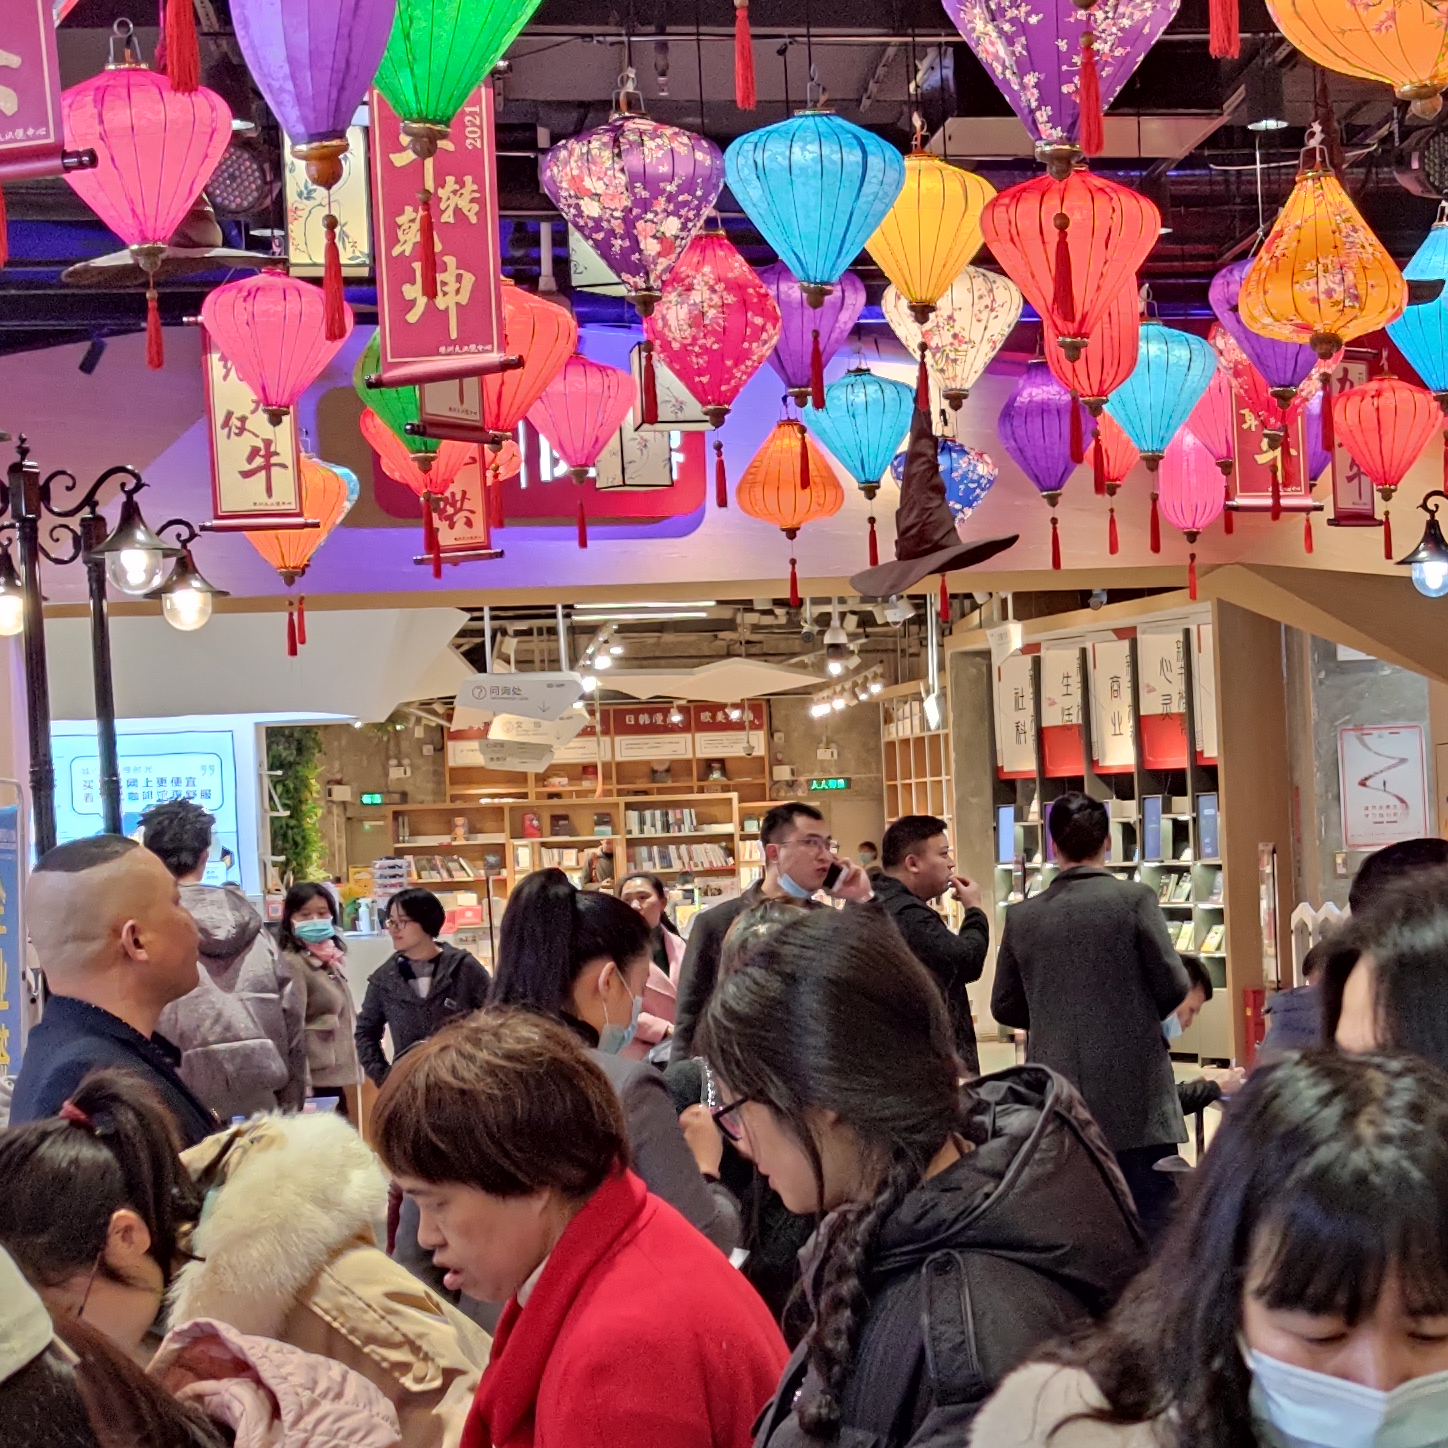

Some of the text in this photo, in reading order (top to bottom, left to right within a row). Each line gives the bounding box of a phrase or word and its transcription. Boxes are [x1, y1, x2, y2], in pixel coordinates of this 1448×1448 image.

[464, 103, 482, 151] 2021
[1013, 686, 1028, 745] 社科
[1108, 674, 1124, 737] 商业
[1158, 656, 1173, 722] 心灵
